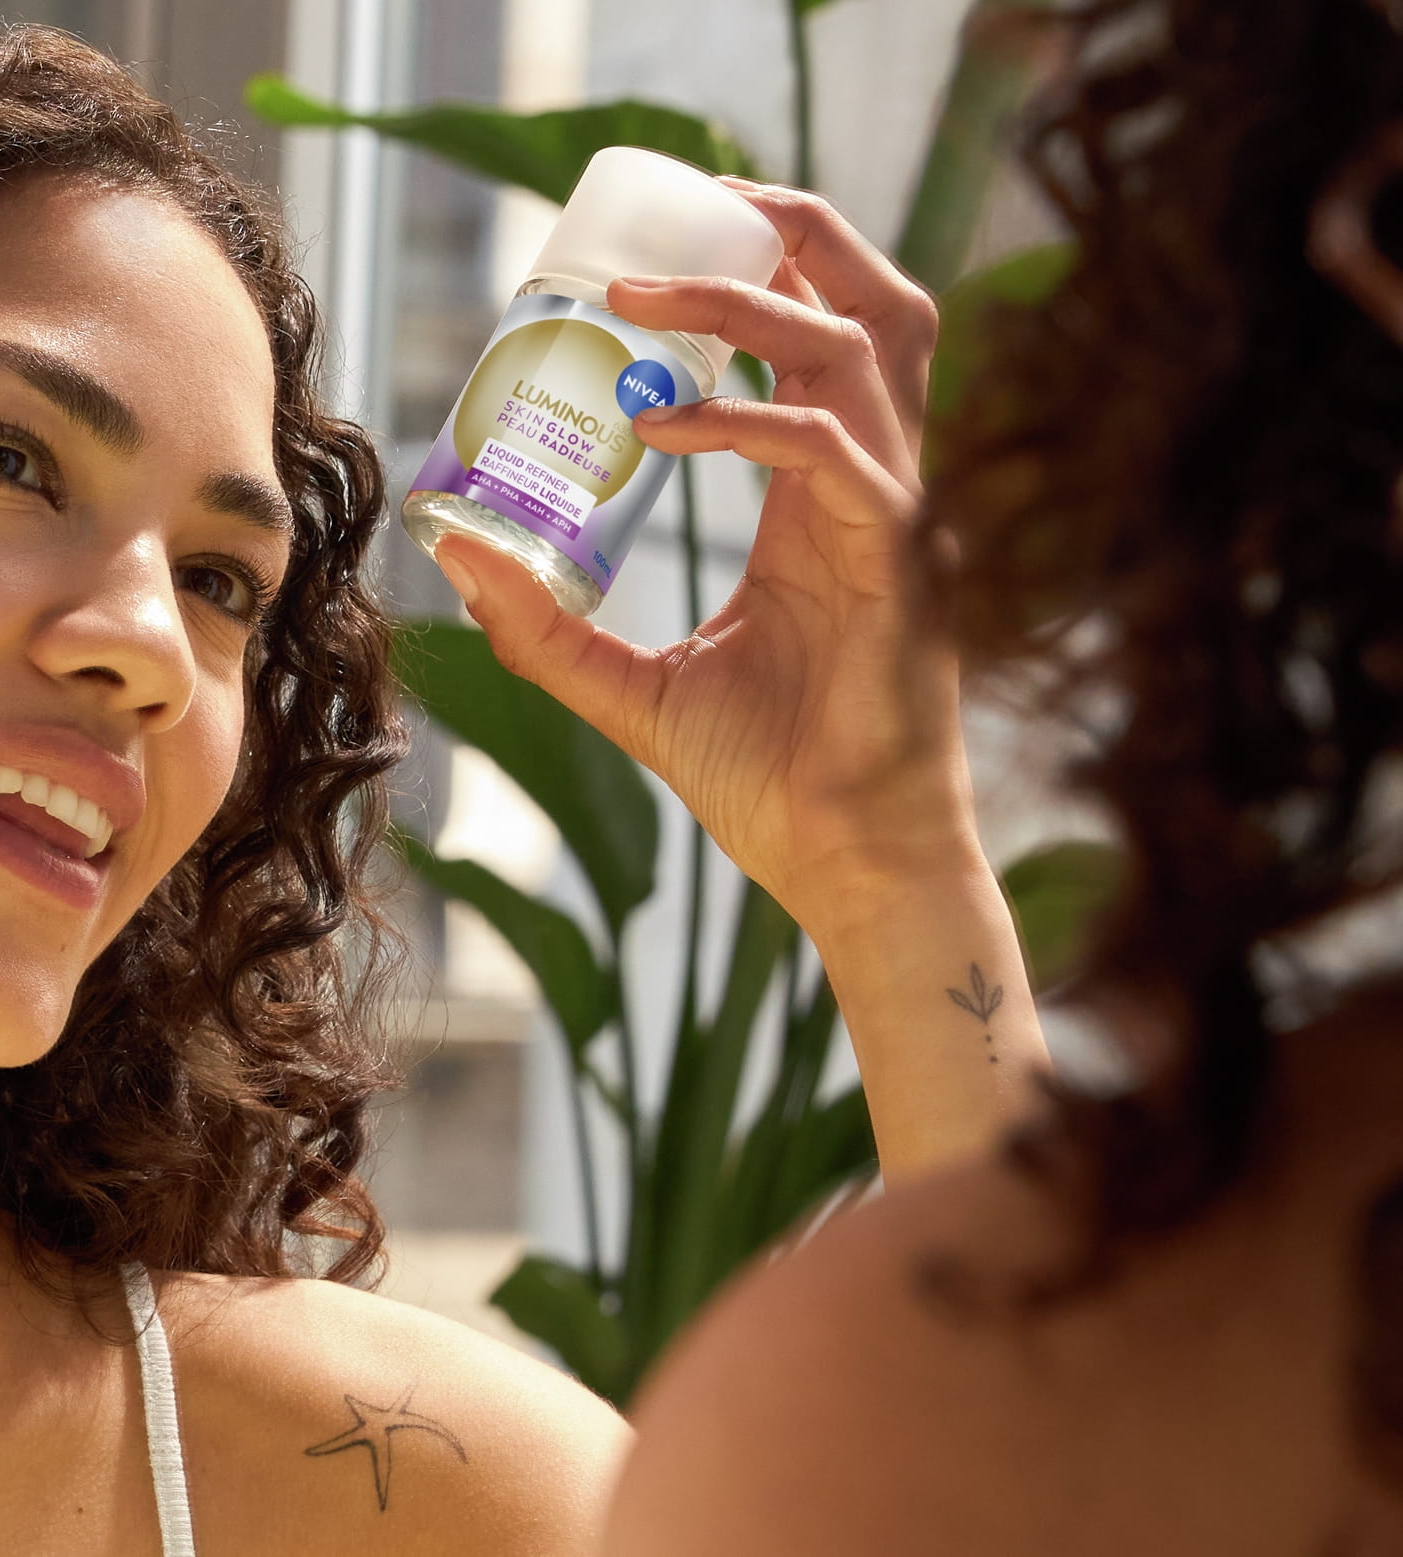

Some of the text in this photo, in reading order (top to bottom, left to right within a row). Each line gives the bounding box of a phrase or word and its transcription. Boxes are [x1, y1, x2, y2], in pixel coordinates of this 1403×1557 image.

[511, 379, 628, 453] LUMINOUS
[623, 374, 666, 407] NIVEA
[497, 412, 611, 483] PEAU RADIEUSE
[503, 400, 595, 453] SKIN GLOW
[480, 456, 583, 518] RAFFINEUR LIQUIDE
[487, 443, 570, 494] LIQUID REFINER
[471, 473, 491, 487] AHA
[500, 485, 520, 503] PHA
[525, 500, 546, 517] AAH
[552, 517, 572, 533] APH
